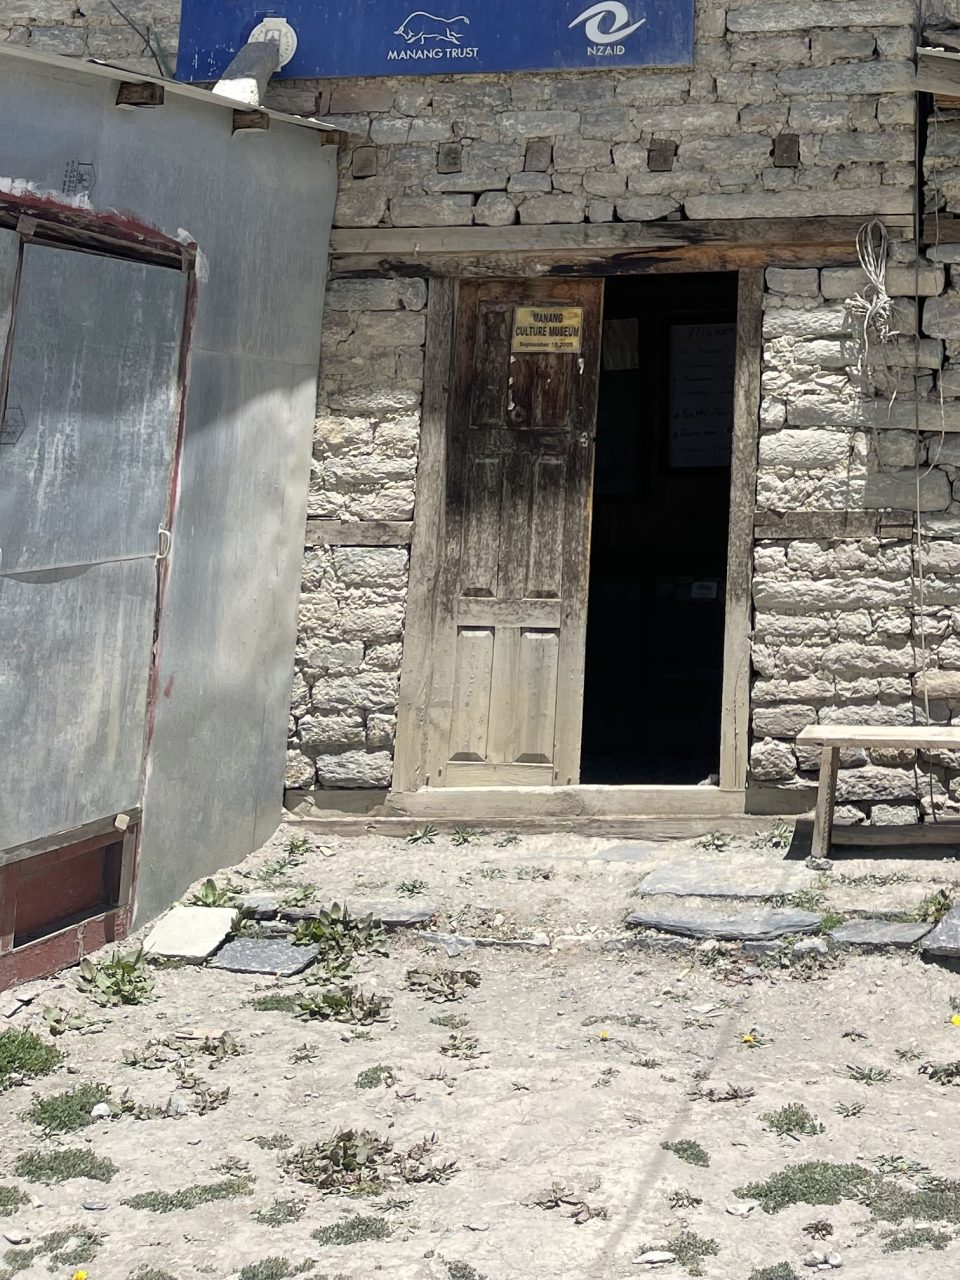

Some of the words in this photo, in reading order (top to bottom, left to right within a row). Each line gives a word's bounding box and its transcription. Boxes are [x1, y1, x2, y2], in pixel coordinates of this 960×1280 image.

[387, 48, 443, 60] MANANG
[444, 46, 479, 59] TRUST
[587, 44, 626, 56] NZAID
[533, 312, 563, 323] MANANG
[515, 326, 547, 337] CULTURE
[549, 325, 579, 337] MUSEUM
